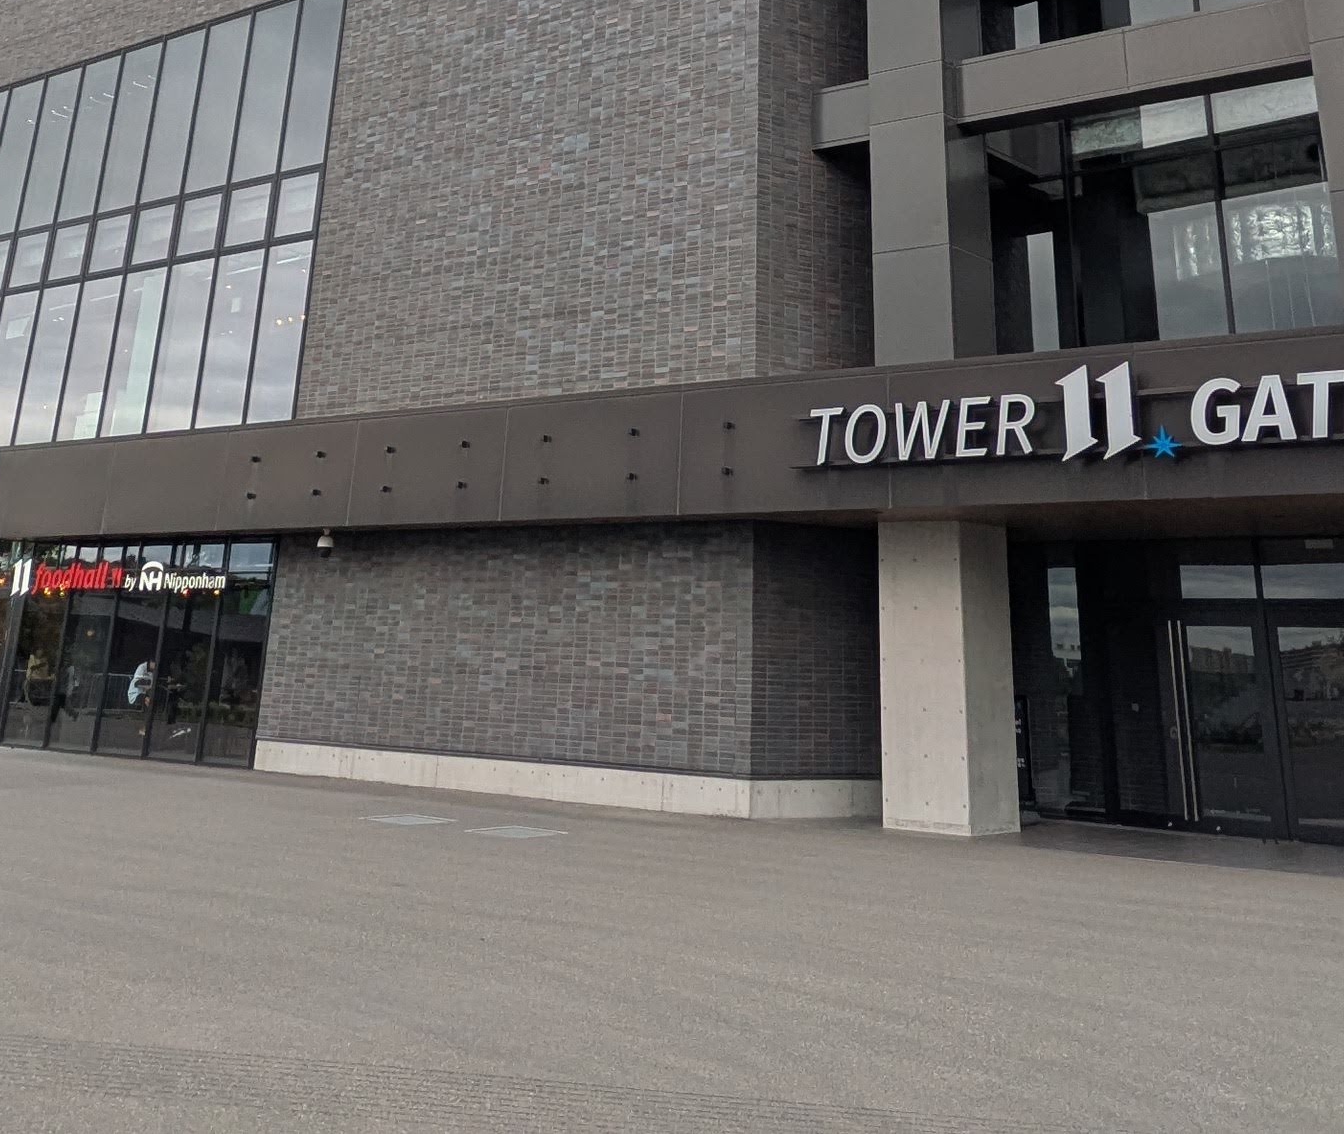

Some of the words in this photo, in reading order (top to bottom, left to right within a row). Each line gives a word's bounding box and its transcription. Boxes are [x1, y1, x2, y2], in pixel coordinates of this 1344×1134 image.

[809, 393, 1035, 465] TOWER
[1055, 361, 1142, 461] 11
[31, 562, 109, 595] foodhall
[124, 574, 136, 592] by
[139, 569, 163, 591] NH
[163, 571, 226, 594] Nipponham
